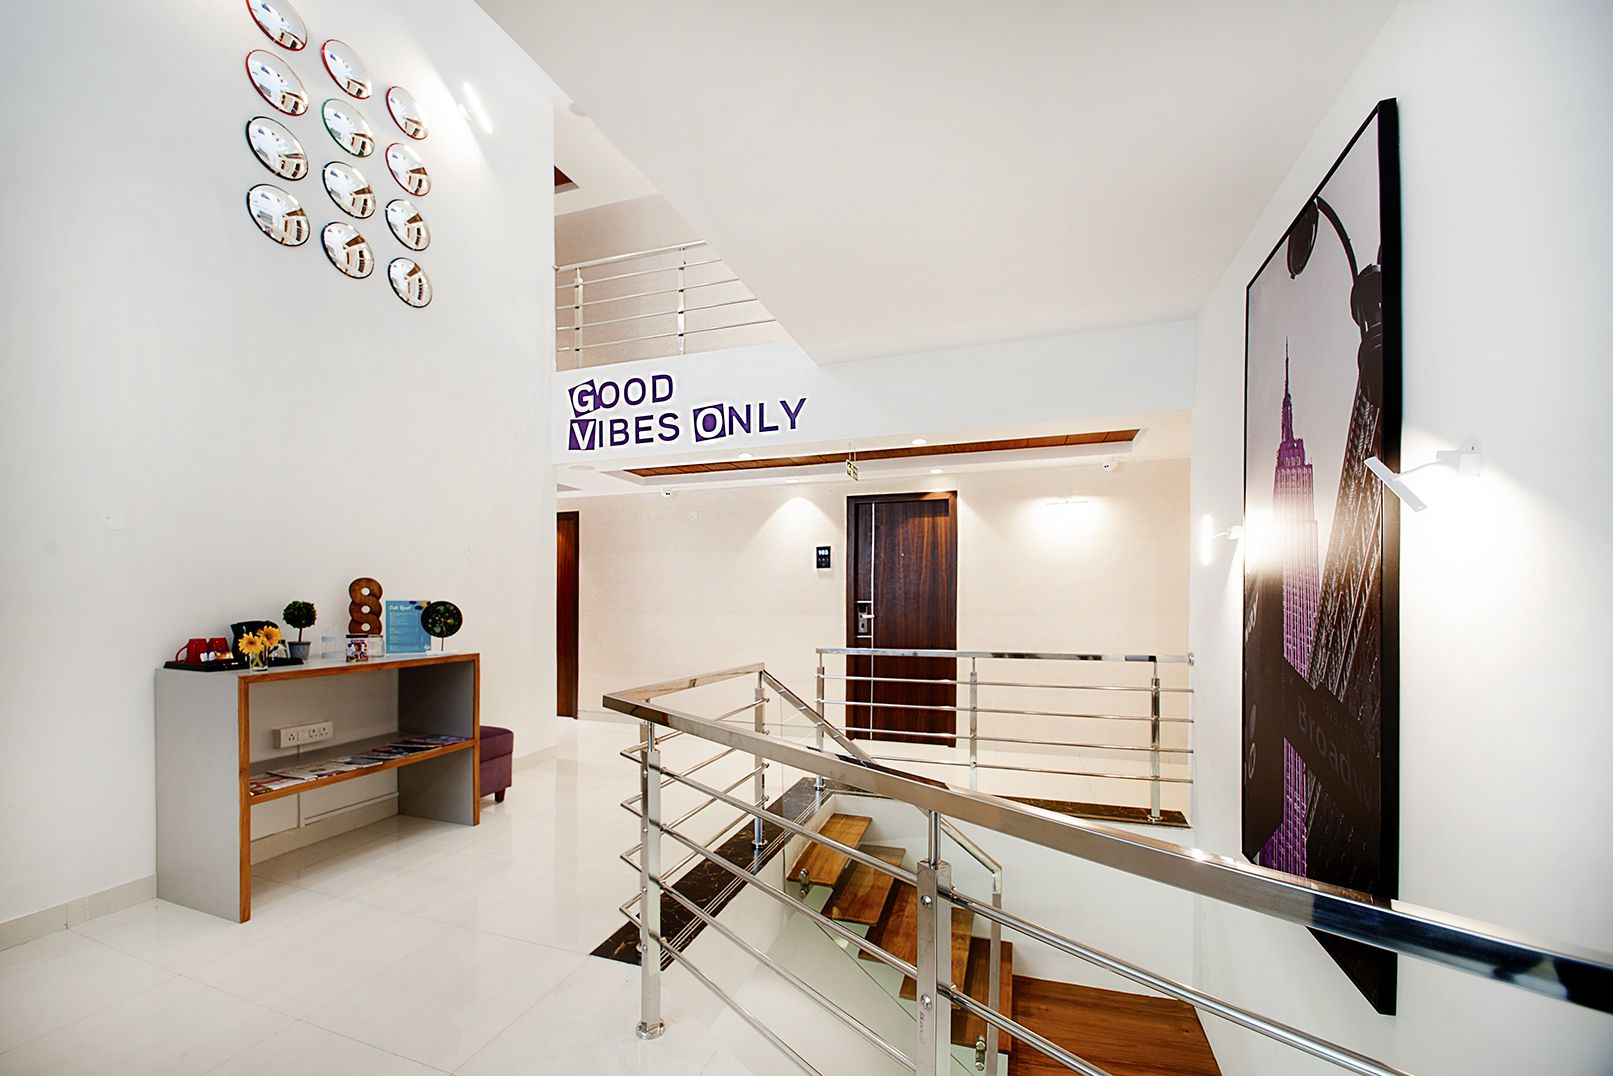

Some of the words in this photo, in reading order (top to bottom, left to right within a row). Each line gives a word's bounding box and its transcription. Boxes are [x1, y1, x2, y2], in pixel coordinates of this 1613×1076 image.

[569, 374, 674, 417] GOOD
[568, 412, 680, 450] VIBES
[693, 398, 807, 442] ONLY
